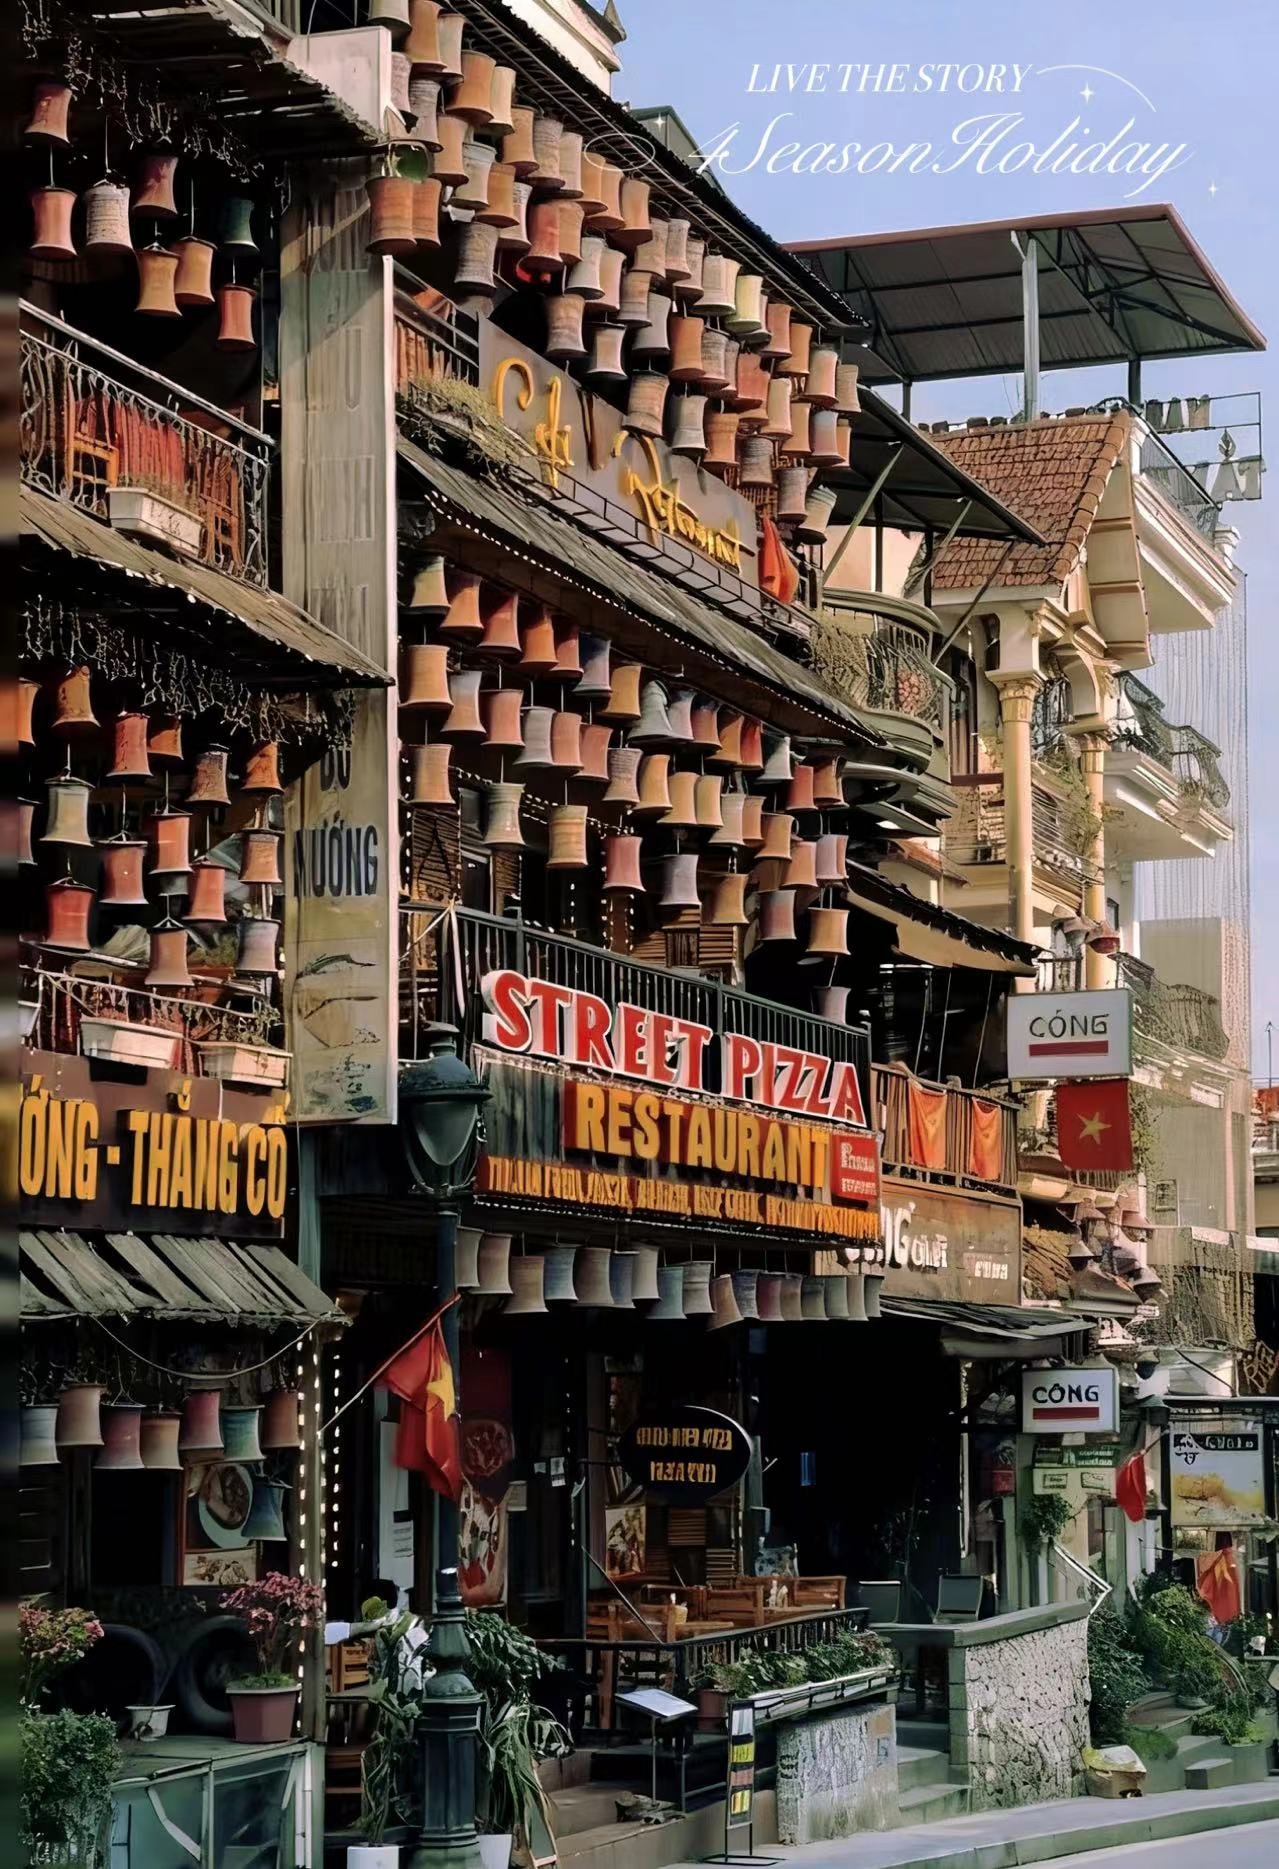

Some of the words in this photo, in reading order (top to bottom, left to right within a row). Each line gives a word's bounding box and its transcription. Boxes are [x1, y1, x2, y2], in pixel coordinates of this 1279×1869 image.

[481, 969, 715, 1090] STREET
[724, 1031, 868, 1128] PIZZA
[576, 1082, 831, 1188] RESTAURANT
